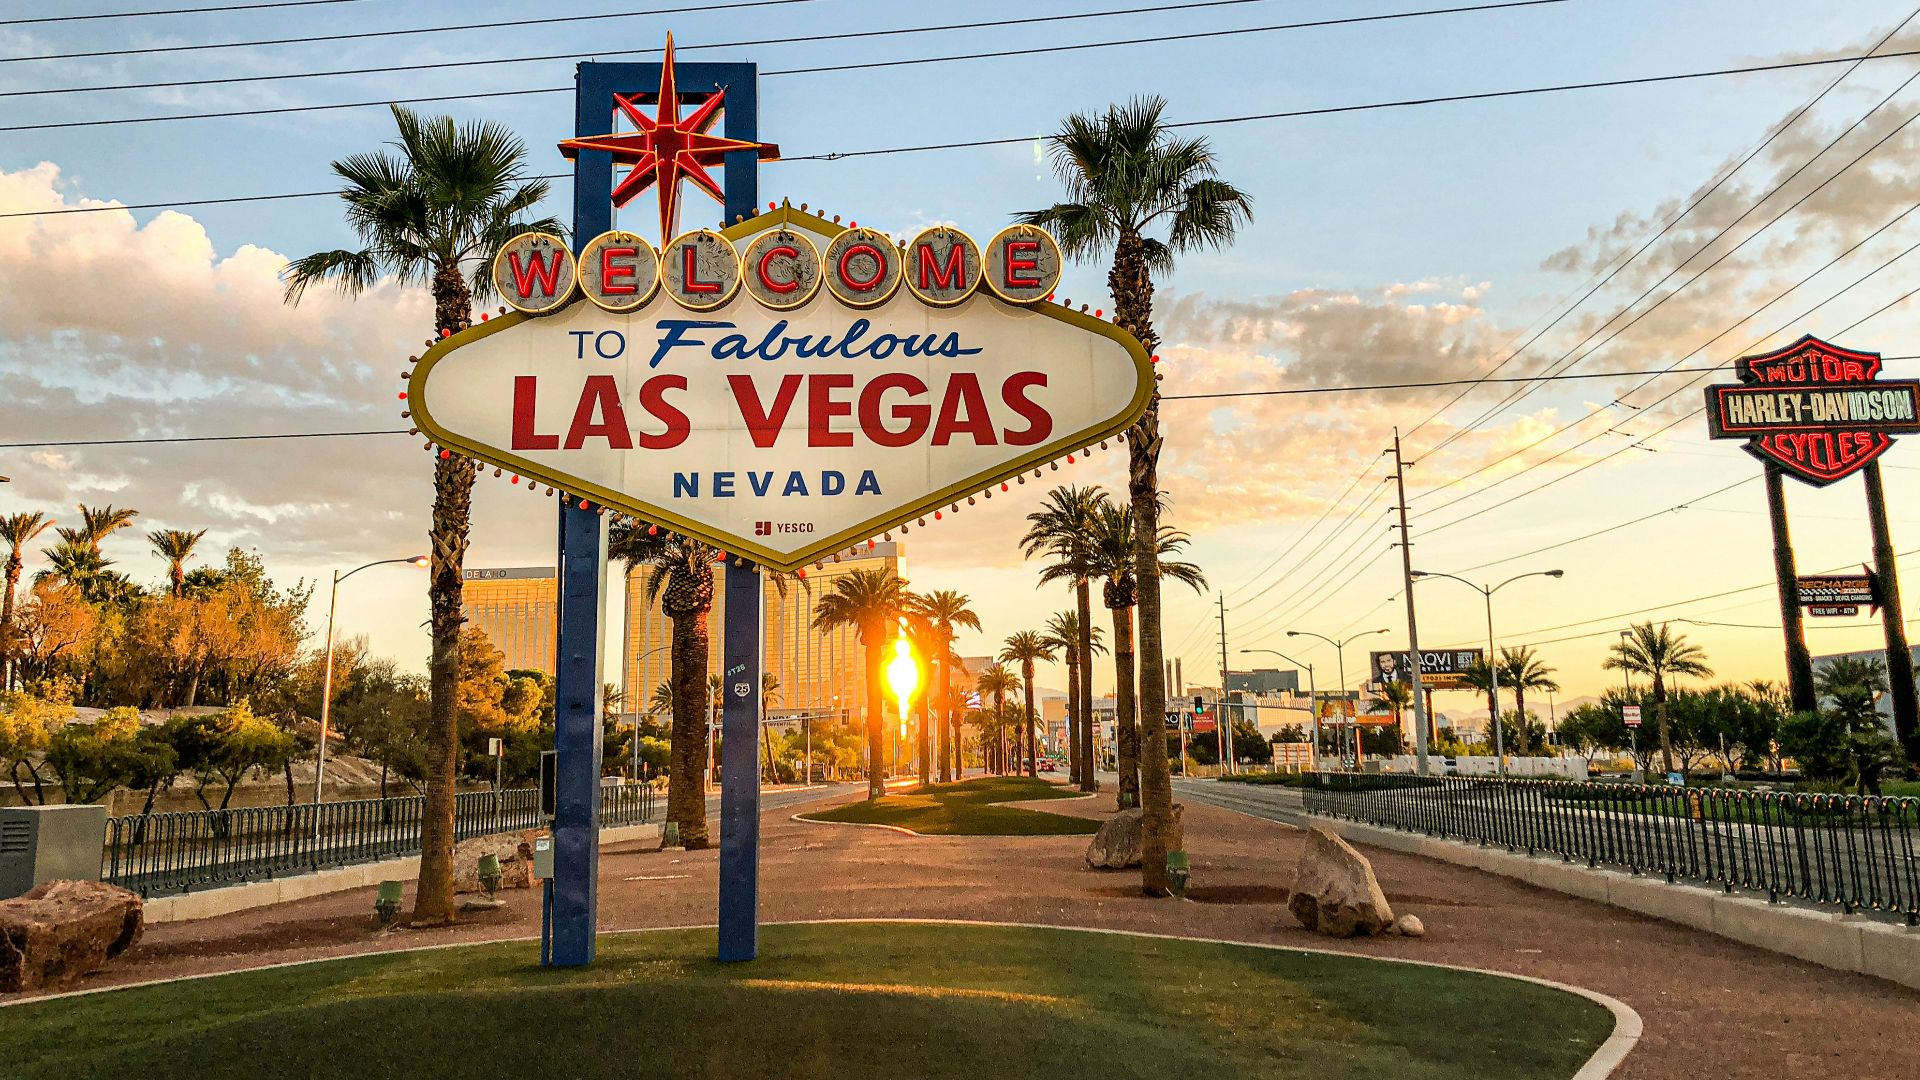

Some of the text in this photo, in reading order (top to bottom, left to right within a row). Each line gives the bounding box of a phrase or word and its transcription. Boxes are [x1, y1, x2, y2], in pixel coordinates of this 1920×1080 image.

[508, 241, 1041, 298] WELCOME
[569, 319, 983, 368] TO Fabulous
[1767, 349, 1864, 382] MOTOR
[511, 372, 1053, 450] LAS VEGAS
[1728, 391, 1912, 424] HARLEY-DAVIDSON
[1775, 432, 1873, 470] CYCLES
[673, 470, 883, 498] NEVADA
[777, 523, 814, 533] YESCO
